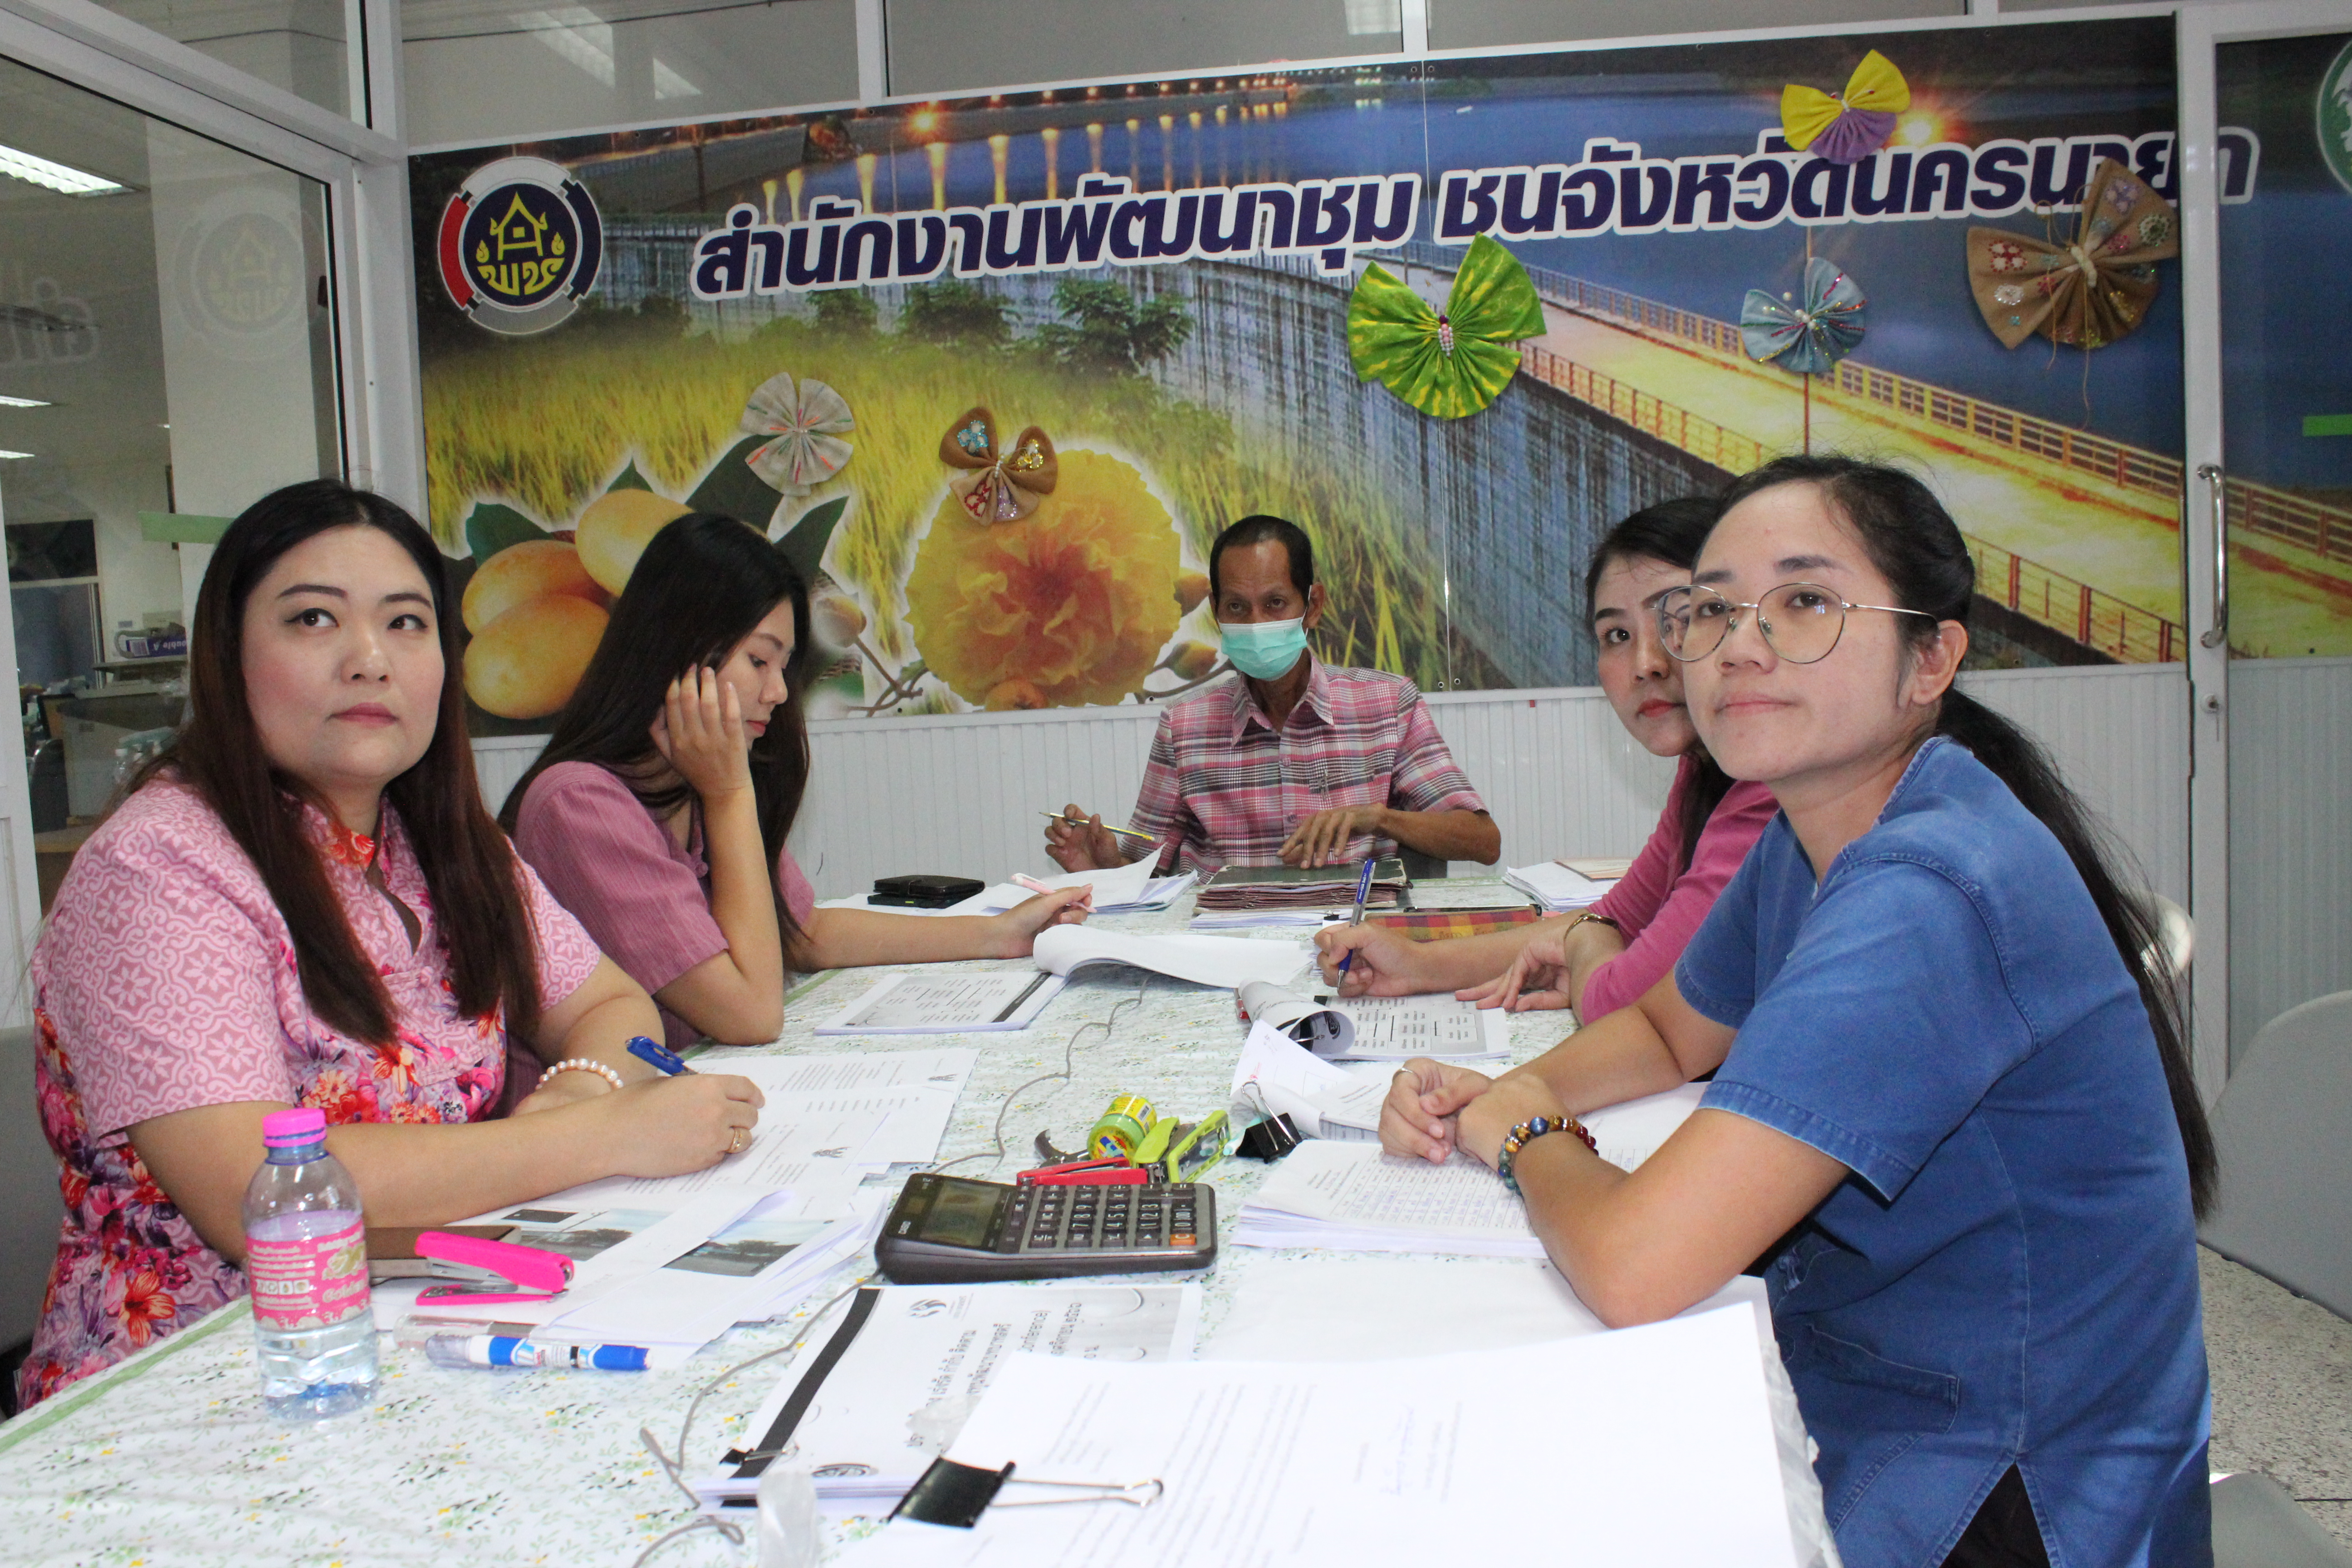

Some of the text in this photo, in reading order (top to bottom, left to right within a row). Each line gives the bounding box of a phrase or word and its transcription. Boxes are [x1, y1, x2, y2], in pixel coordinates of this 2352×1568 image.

[695, 178, 1416, 294] สำนักงานพัฒนาชุม
[153, 640, 186, 651] ouble A
